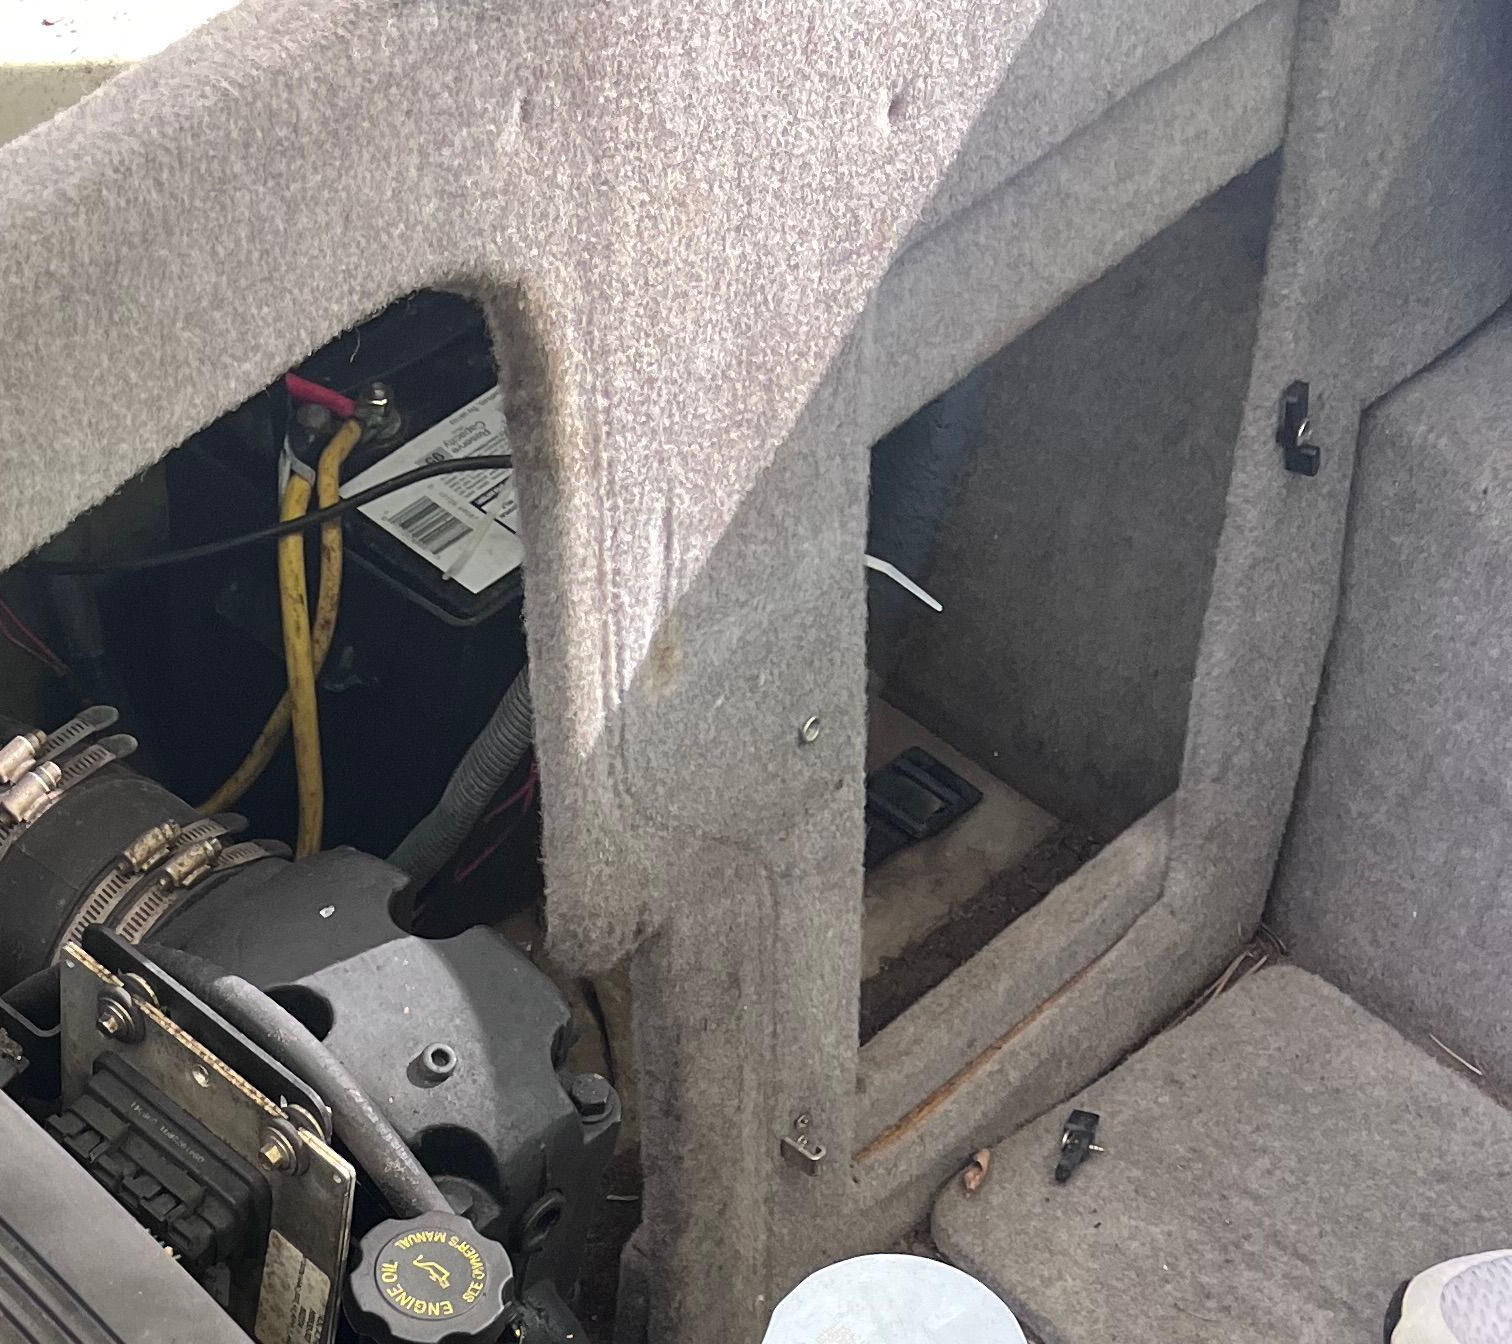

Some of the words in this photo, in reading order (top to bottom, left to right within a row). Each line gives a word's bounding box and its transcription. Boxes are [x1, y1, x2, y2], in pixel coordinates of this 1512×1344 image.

[394, 1230, 447, 1250] MANUAL
[448, 1235, 486, 1280] OWNER'S
[381, 1261, 399, 1283] OIL
[386, 1283, 454, 1316] ENGINE
[462, 1281, 484, 1303] SEE
